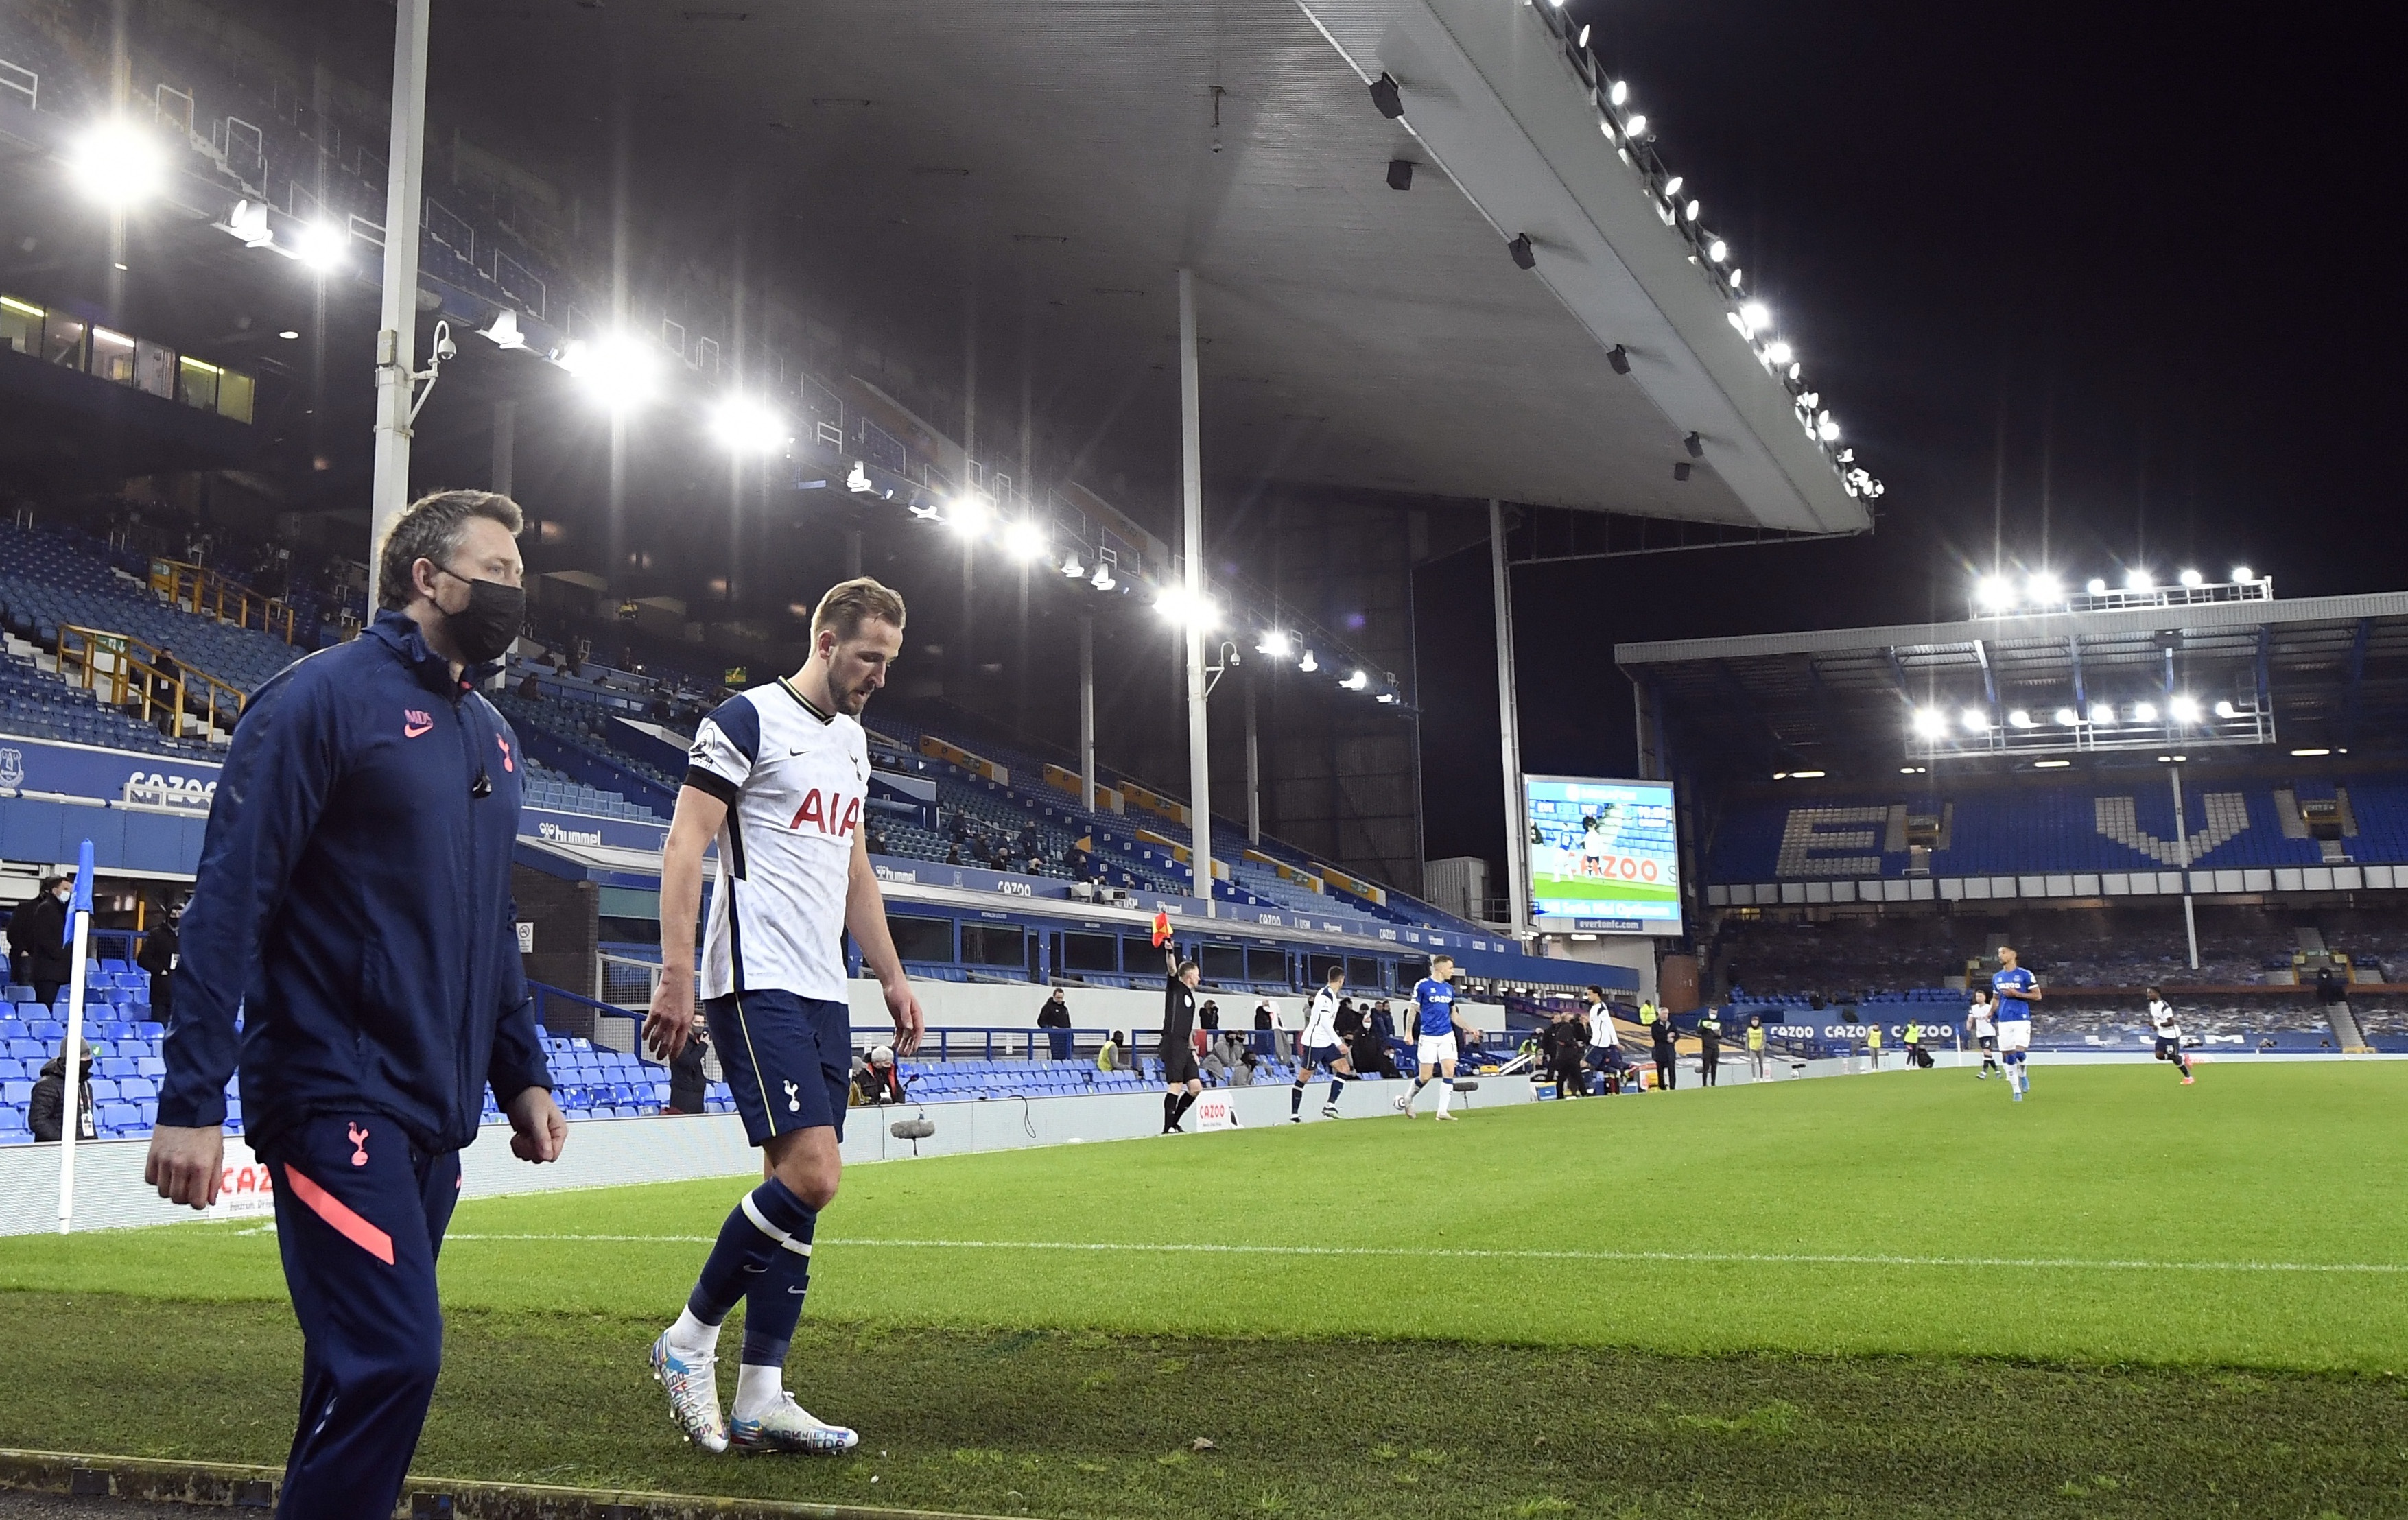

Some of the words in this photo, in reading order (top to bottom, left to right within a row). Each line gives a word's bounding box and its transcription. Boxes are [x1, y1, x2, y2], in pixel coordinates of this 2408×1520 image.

[790, 788, 860, 838] AIA
[556, 824, 601, 846] hummel
[1568, 851, 1657, 881] AZOO
[886, 866, 916, 883] hummel
[998, 880, 1032, 897] CAZOO
[1258, 913, 1282, 926] CAZOO
[1579, 919, 1639, 929] evertonfc.com
[1429, 995, 1452, 1004] CAZO
[1771, 1026, 1814, 1038] CAZOO
[1824, 1025, 1874, 1038] CAZO
[1891, 1025, 1952, 1038] CZOO
[1199, 1104, 1225, 1119] CAZOO
